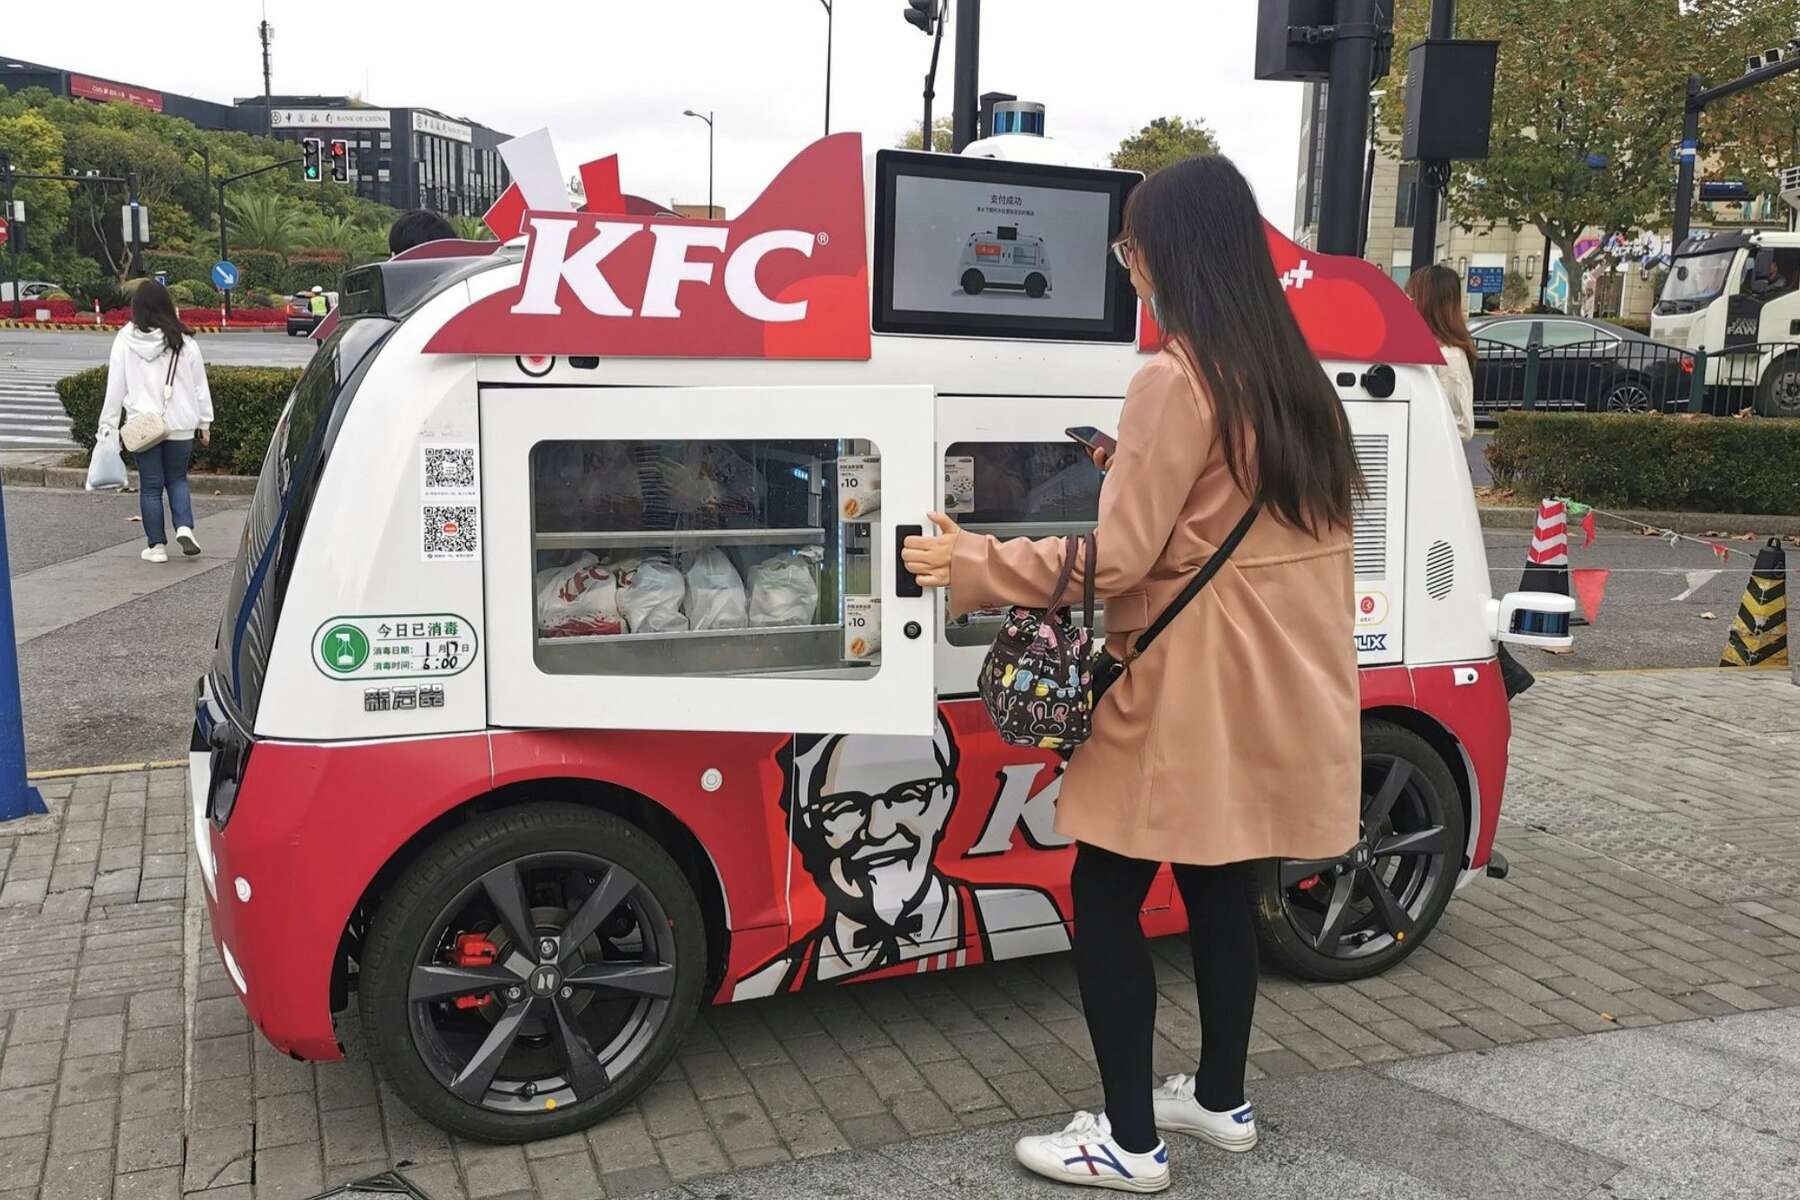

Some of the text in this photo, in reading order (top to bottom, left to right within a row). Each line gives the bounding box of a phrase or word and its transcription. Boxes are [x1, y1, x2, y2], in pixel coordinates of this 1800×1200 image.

[991, 194, 1022, 206] 支付成功
[510, 216, 816, 323] KFC
[377, 621, 460, 638] 今日已消毒
